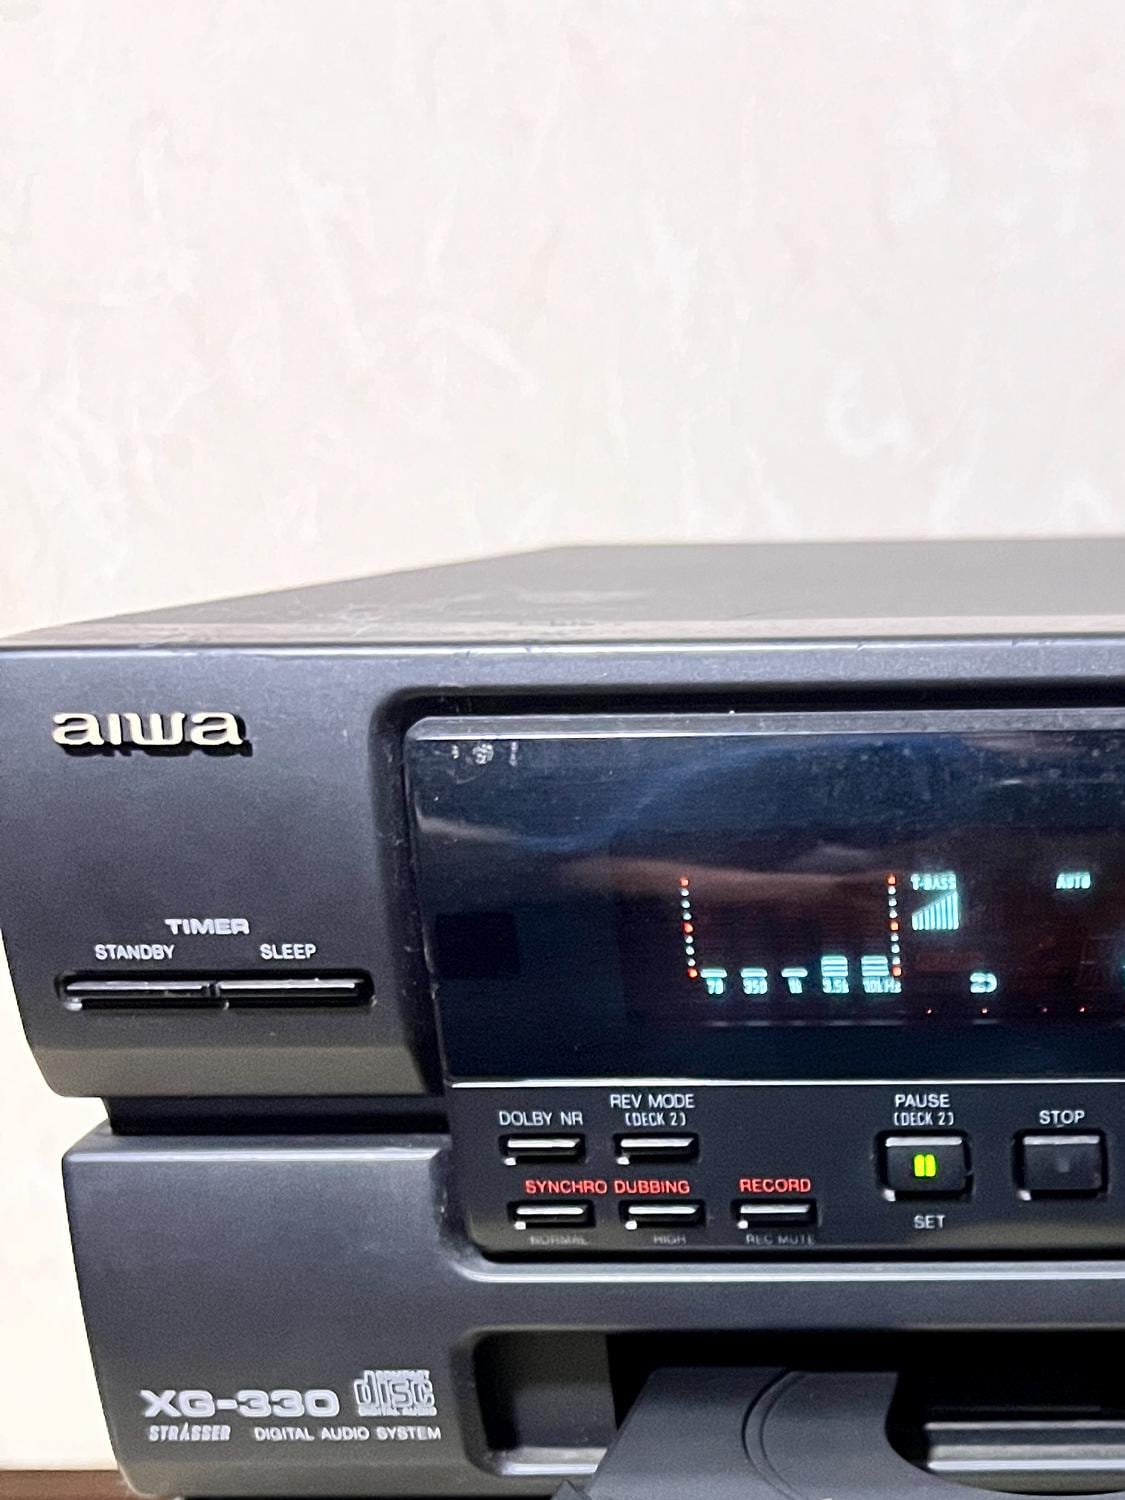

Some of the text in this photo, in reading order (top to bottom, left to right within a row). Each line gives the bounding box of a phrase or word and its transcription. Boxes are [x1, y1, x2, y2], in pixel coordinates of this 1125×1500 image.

[53, 712, 244, 746] aiwa
[910, 873, 957, 890] T-BASS
[1056, 871, 1091, 889] AUTO
[165, 919, 250, 935] TIMER
[95, 944, 175, 960] STANDBY
[260, 944, 317, 959] SLEEP
[742, 977, 769, 994] 350
[610, 1094, 694, 1109] REV MODE
[895, 1094, 950, 1108] PAUSE
[499, 1111, 583, 1126] DOLBY NR
[1039, 1110, 1085, 1124] STOP
[525, 1180, 690, 1195] SYNCHRO DUBBING
[739, 1179, 811, 1193] RECORD
[914, 1215, 945, 1229] SET
[653, 1235, 687, 1245] HIGH
[779, 1233, 815, 1245] MUTE
[140, 1389, 340, 1417] XG-330
[255, 1427, 441, 1440] DIGITAL AUDIO SYSTEM
